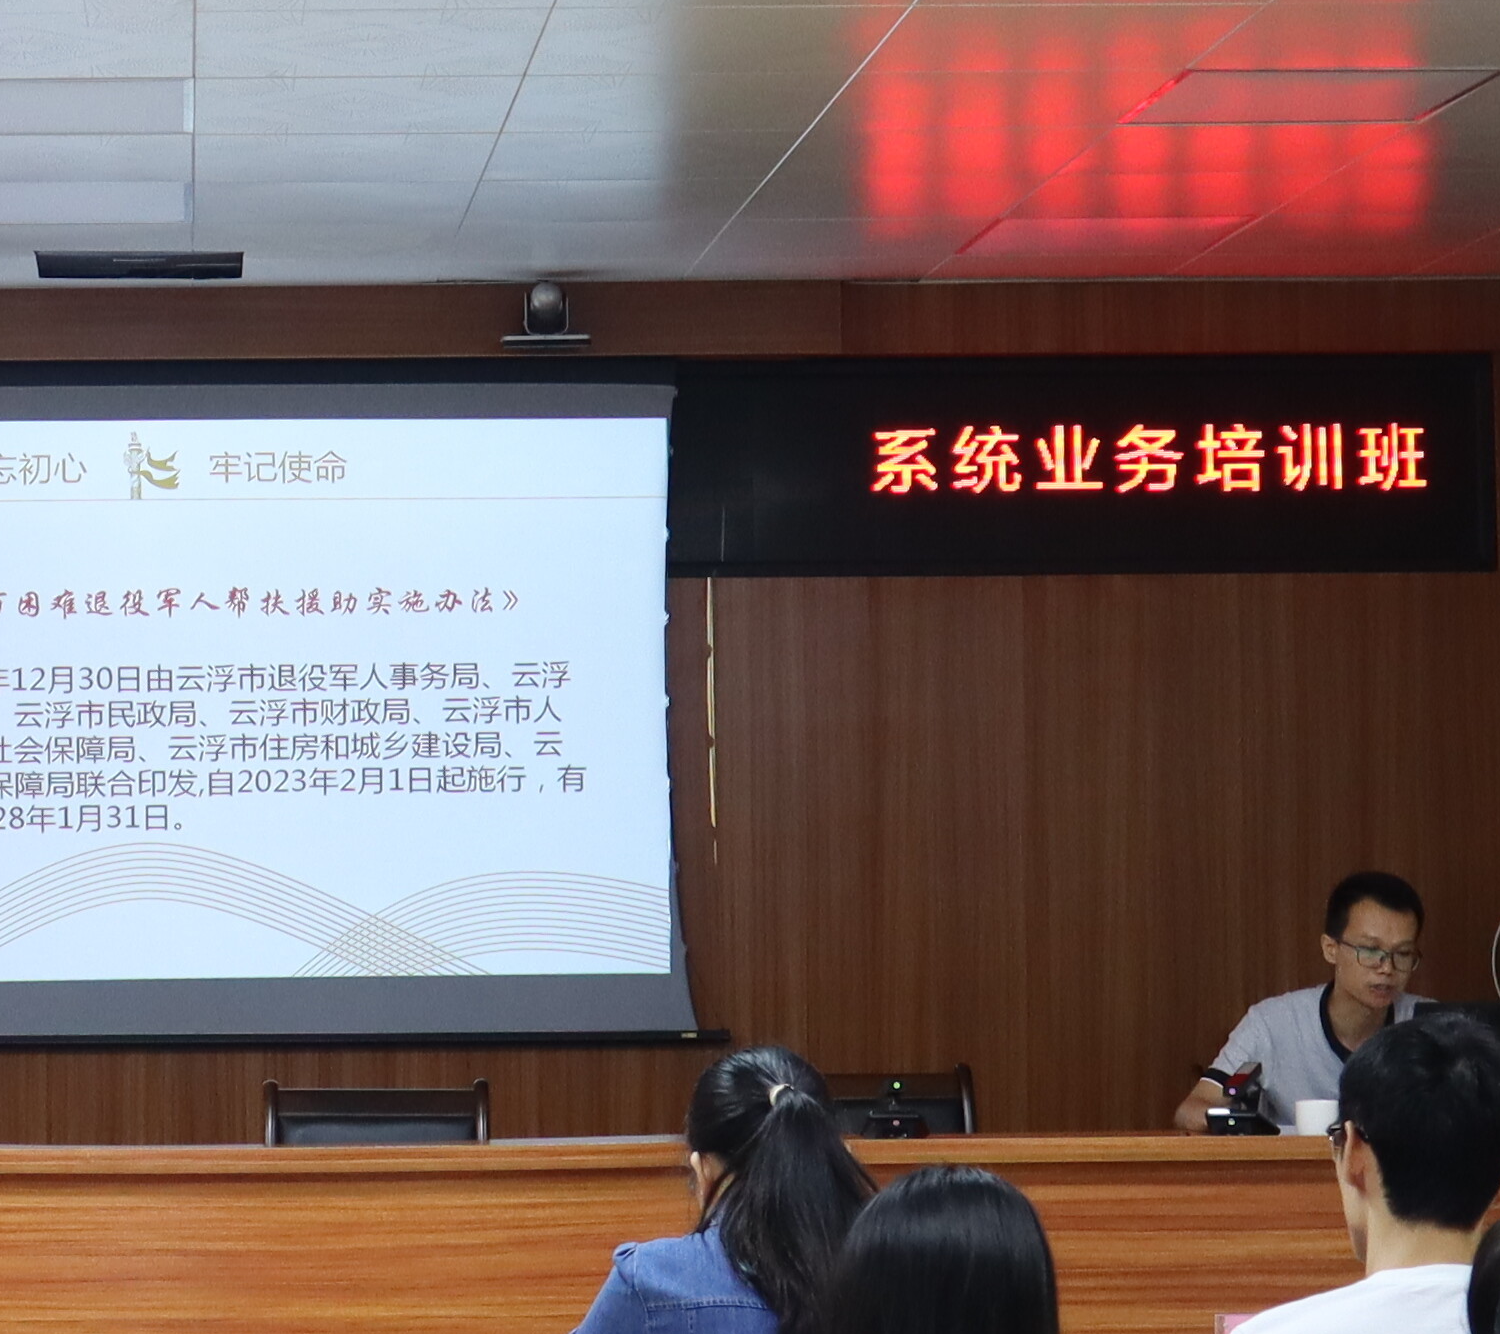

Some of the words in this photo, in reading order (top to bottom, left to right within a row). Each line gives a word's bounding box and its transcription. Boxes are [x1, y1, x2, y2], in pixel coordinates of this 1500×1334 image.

[209, 451, 348, 485] 牢记使命
[870, 423, 1429, 494] 系统业务培训班
